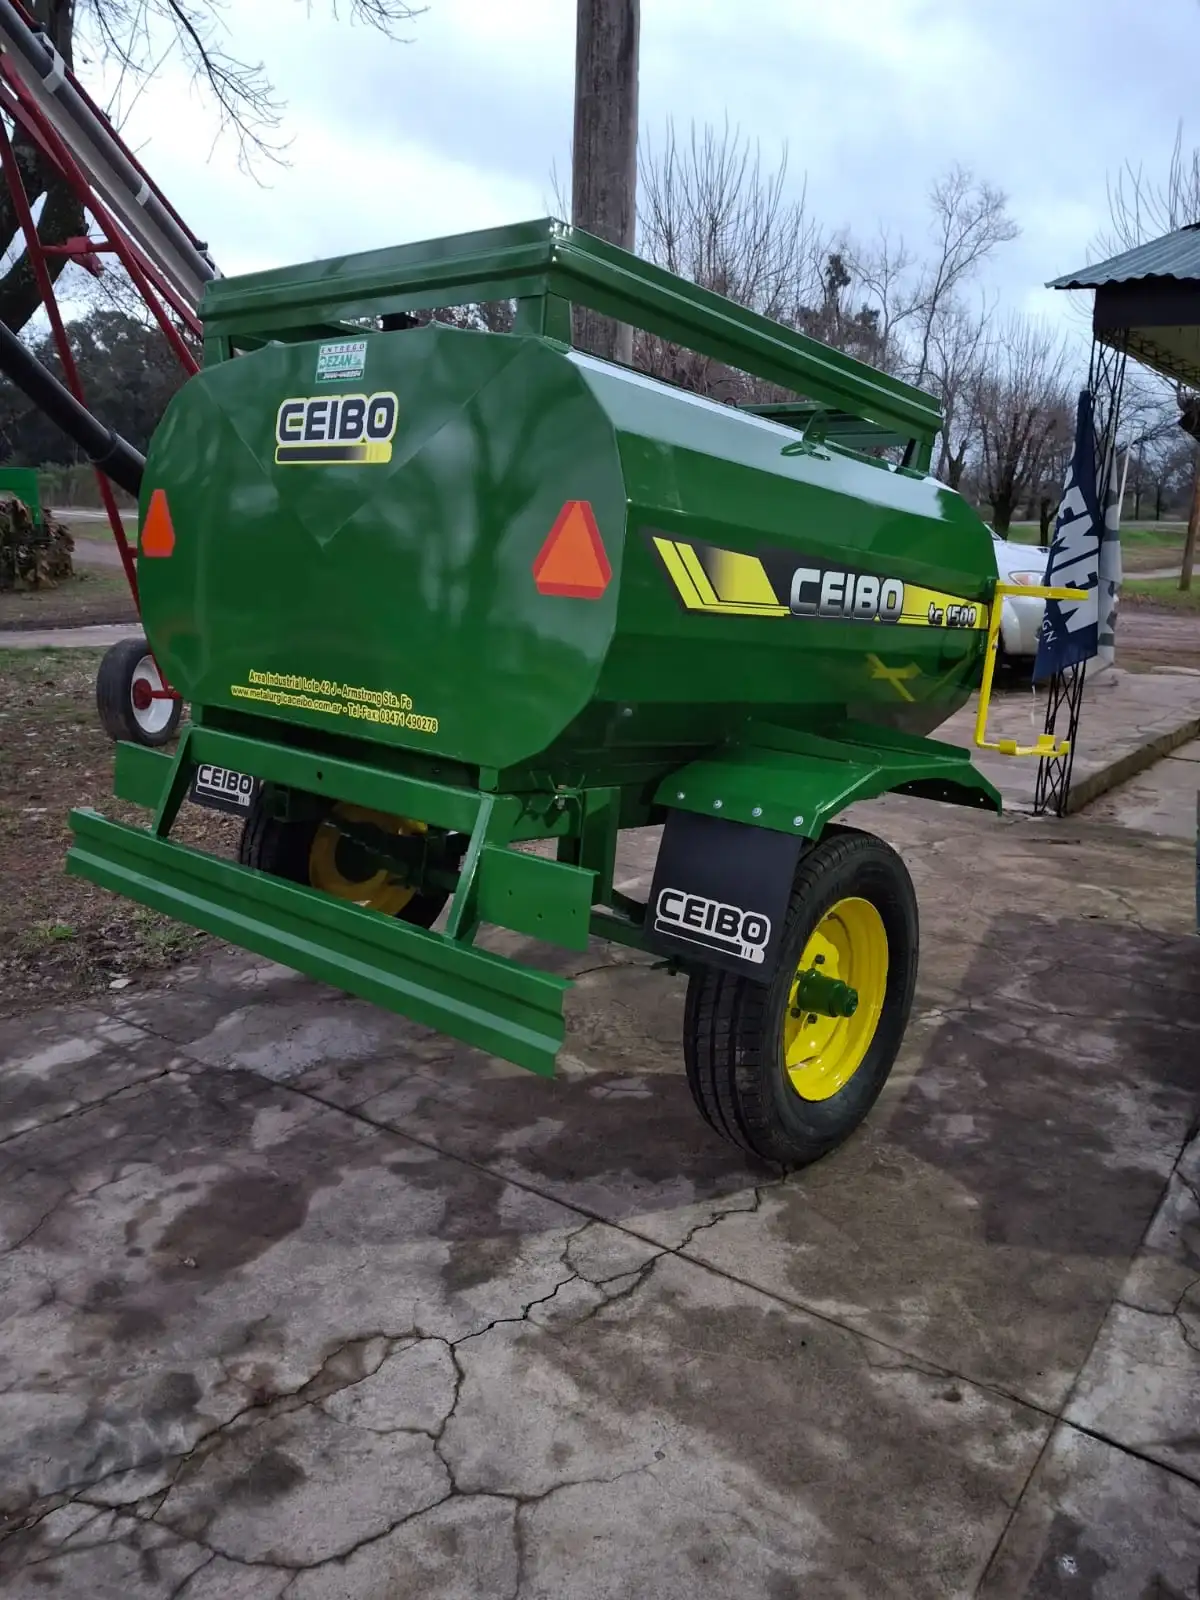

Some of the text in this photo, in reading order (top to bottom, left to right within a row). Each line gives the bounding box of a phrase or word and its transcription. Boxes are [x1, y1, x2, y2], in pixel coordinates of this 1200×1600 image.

[276, 392, 398, 444] CEIBO
[790, 567, 904, 621] CEIBO
[946, 604, 976, 627] 1500
[231, 685, 342, 715] www.metalurgicaceibo.com.ar
[380, 708, 405, 727] 03471
[405, 713, 439, 734] 490278
[249, 669, 266, 684] Area
[266, 672, 302, 689] Industrial
[320, 680, 331, 695] 42
[331, 682, 337, 696] J
[341, 684, 382, 707] Armstrong
[382, 691, 401, 708] Sta.
[400, 694, 413, 710] Fe
[197, 764, 253, 796] CEIBO
[656, 888, 771, 950] CEIBO
